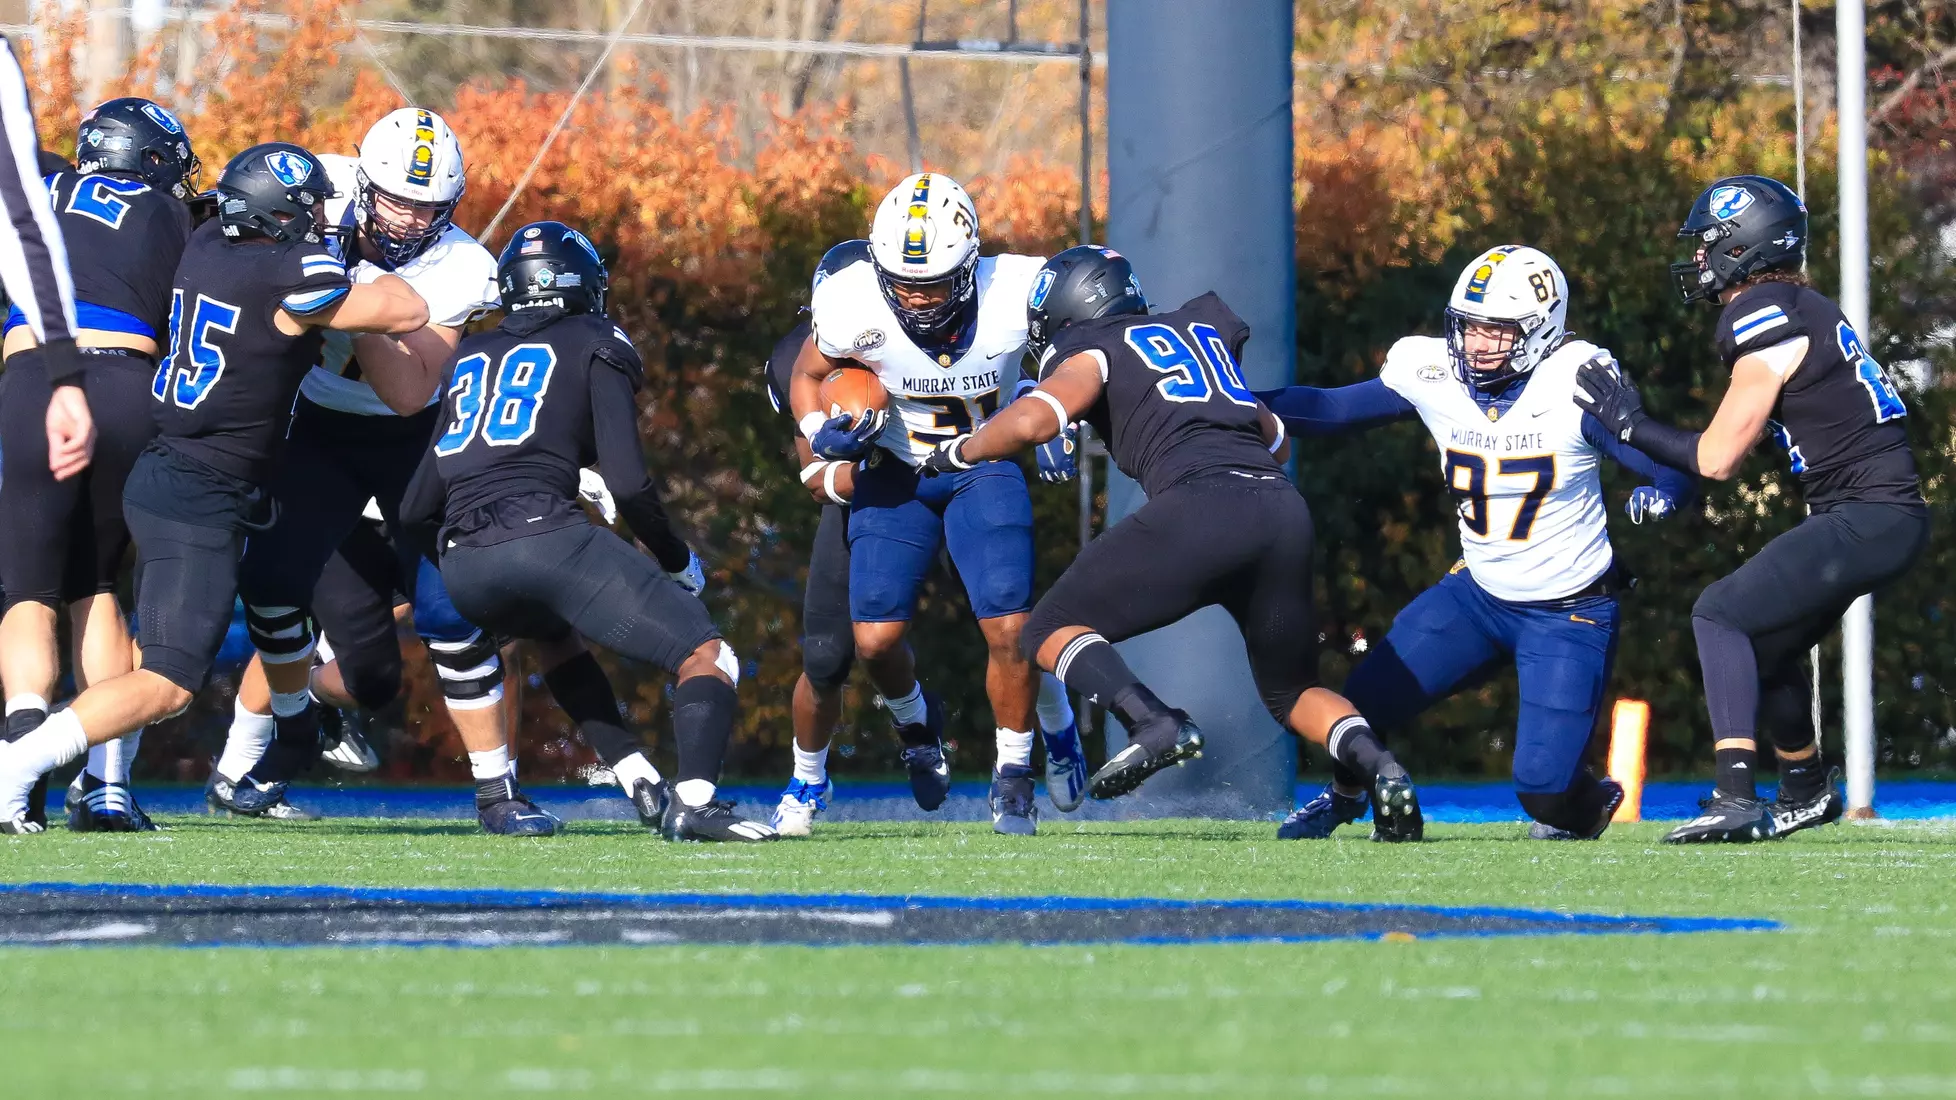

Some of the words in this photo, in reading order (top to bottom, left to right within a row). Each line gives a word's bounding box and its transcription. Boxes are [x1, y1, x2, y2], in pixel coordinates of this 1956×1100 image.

[43, 172, 152, 230] 2
[953, 201, 979, 240] 31
[1528, 269, 1559, 303] 87
[152, 288, 241, 410] 15
[1123, 322, 1258, 409] 90
[434, 343, 557, 457] 38
[902, 376, 956, 393] MURRAY
[962, 369, 1000, 391] STATE
[1450, 427, 1499, 450] MURRAY
[1505, 432, 1543, 451] STATE
